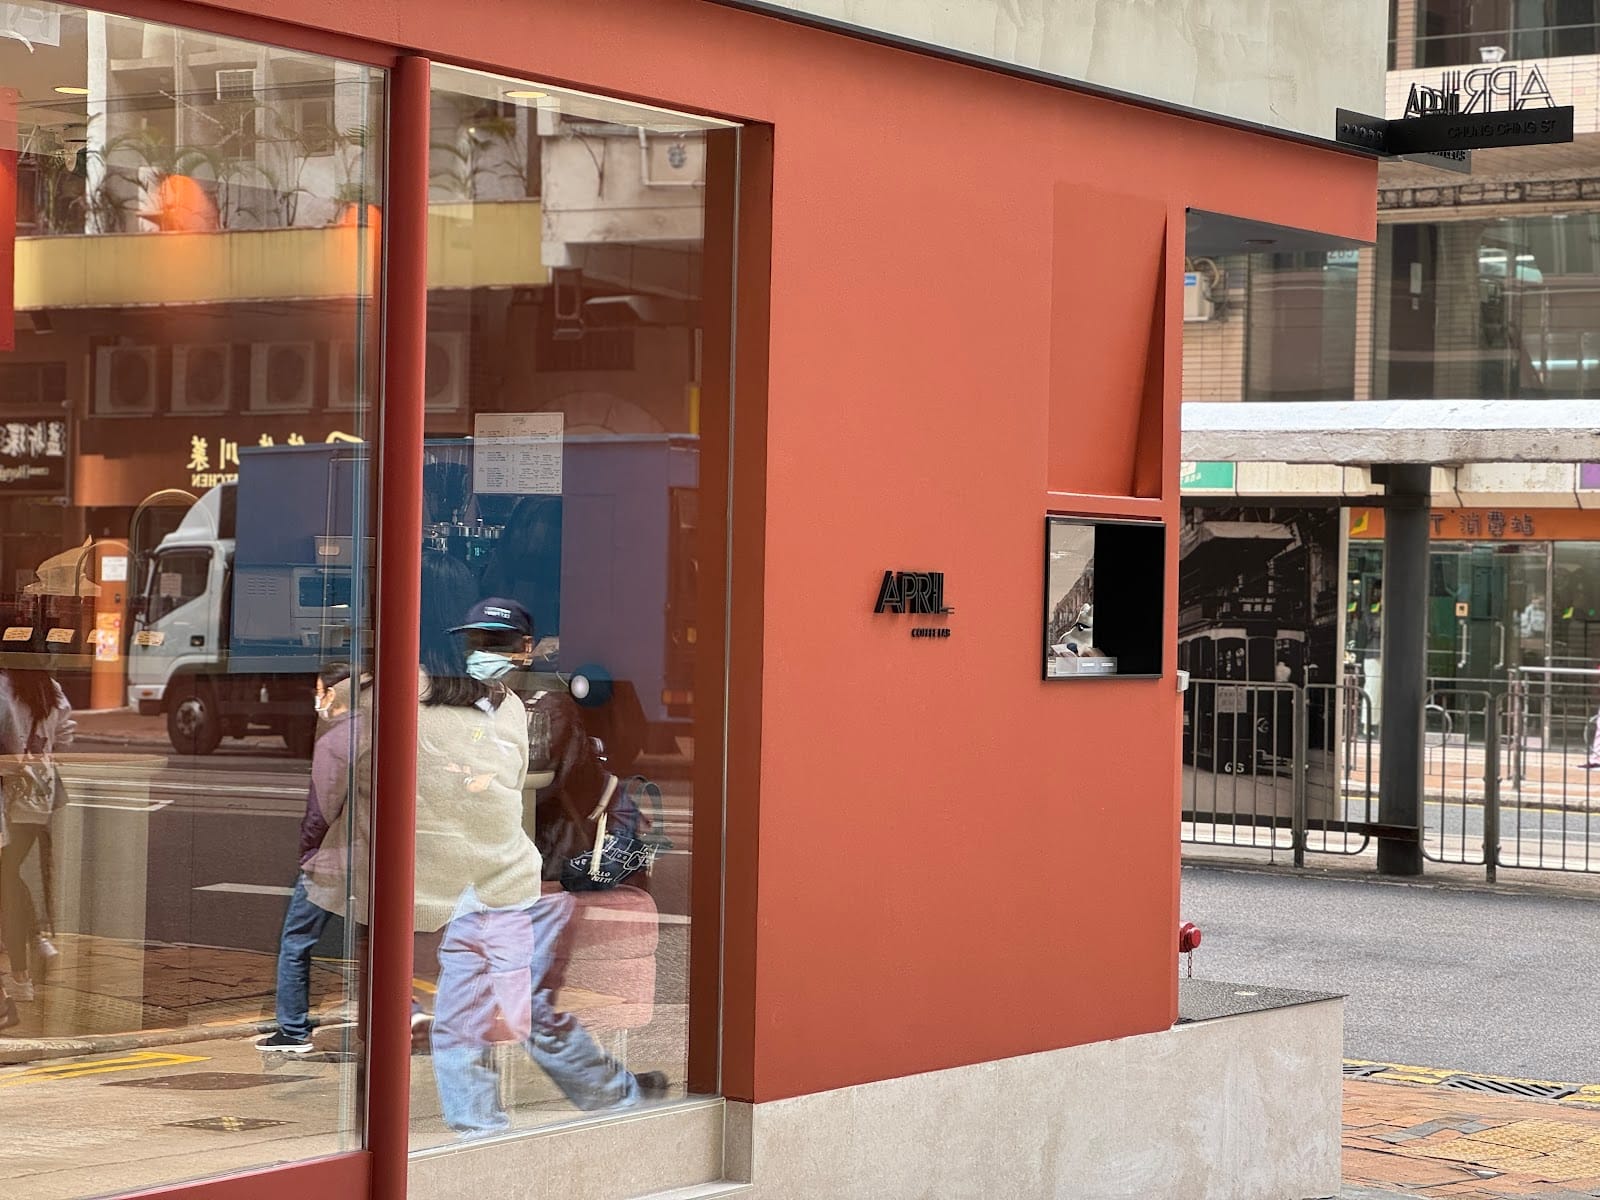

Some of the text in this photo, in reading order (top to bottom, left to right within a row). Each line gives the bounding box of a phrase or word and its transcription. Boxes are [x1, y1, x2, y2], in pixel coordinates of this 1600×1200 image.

[1448, 119, 1556, 139] CHUNG CHING ST
[874, 571, 955, 614] APRIL
[1224, 761, 1246, 774] 65
